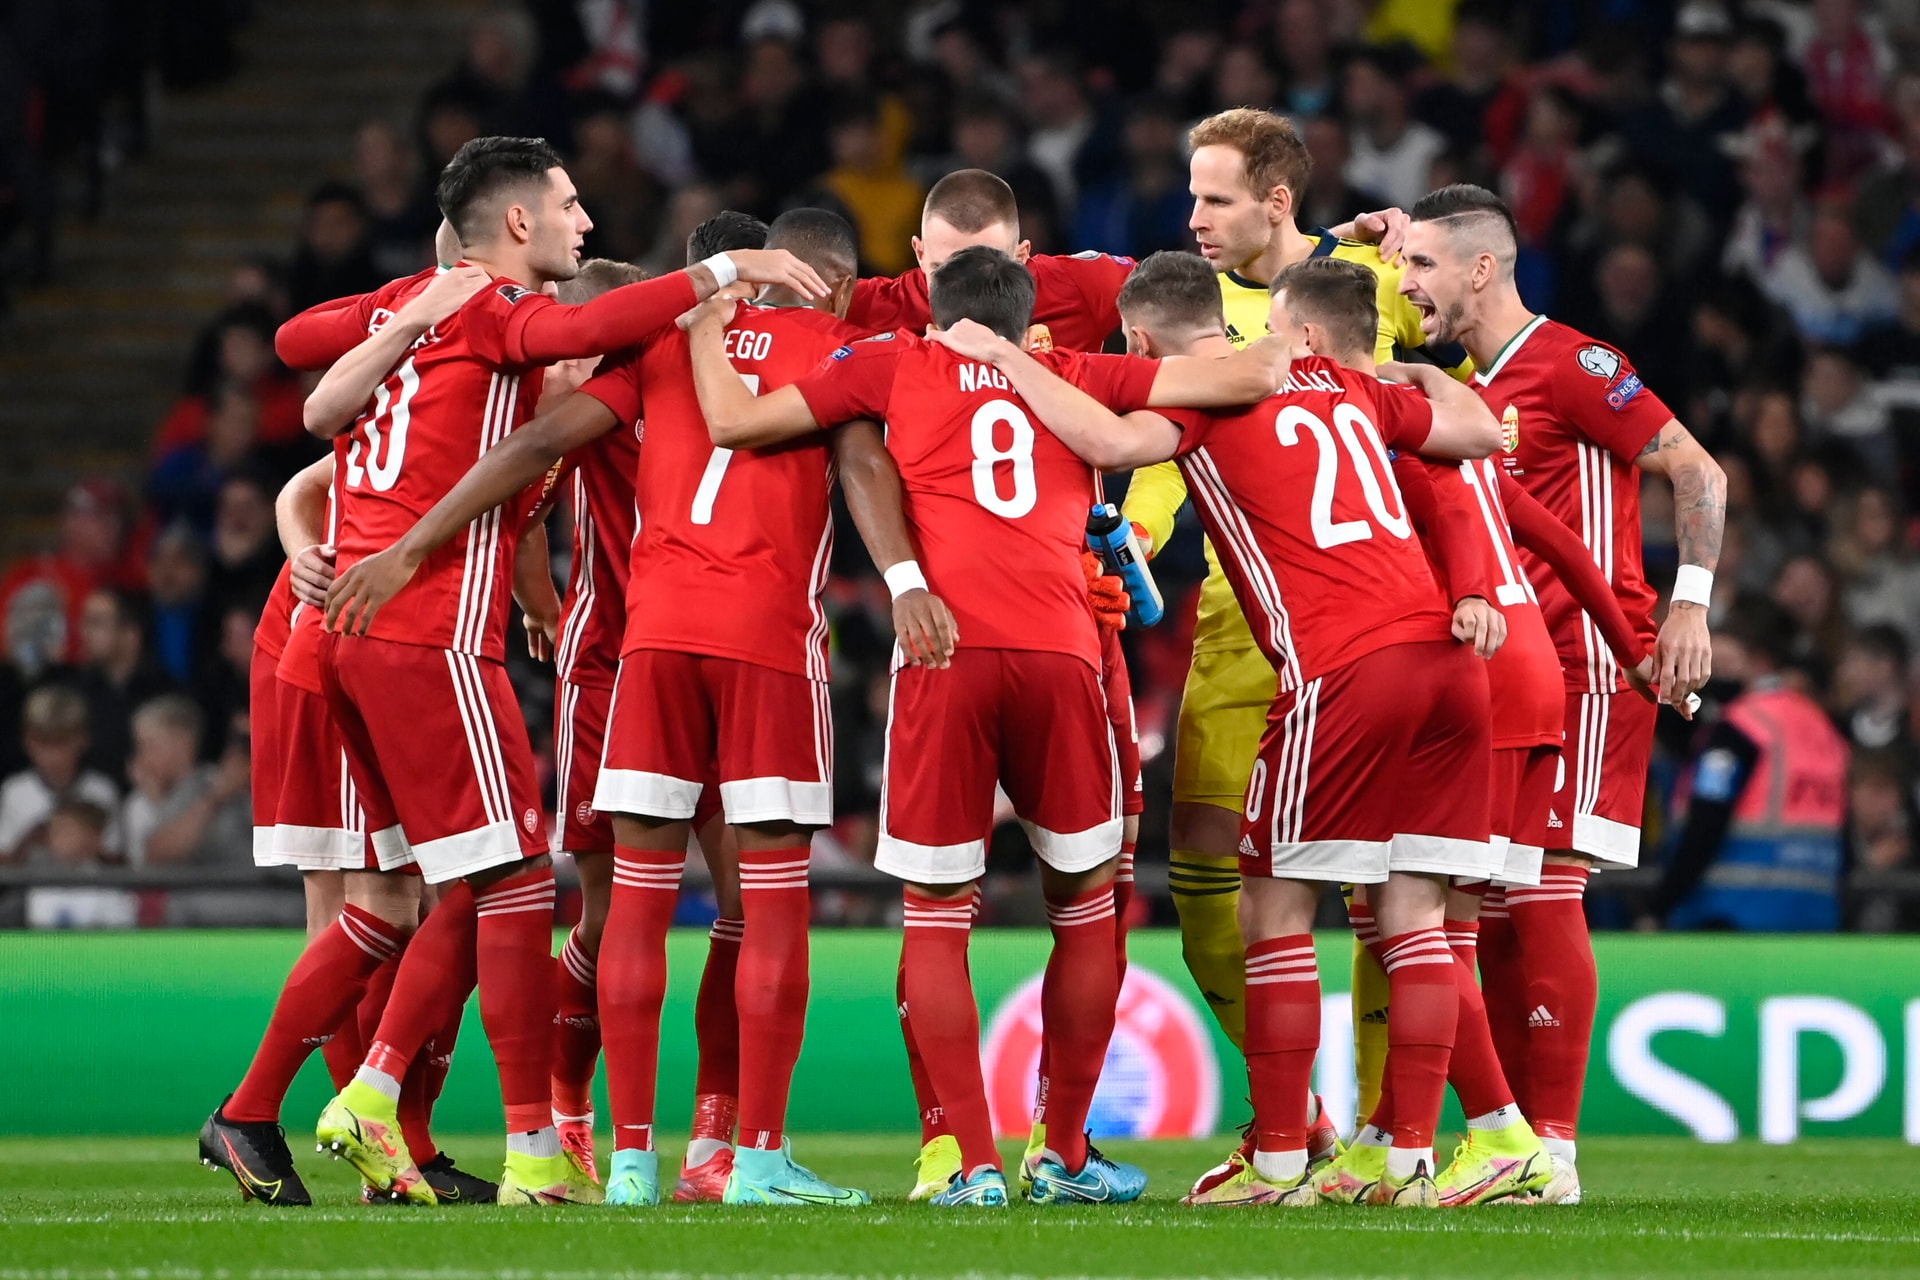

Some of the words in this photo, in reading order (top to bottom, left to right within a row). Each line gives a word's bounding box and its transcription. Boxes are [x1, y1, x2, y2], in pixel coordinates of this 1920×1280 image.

[724, 329, 773, 361] EGO
[959, 362, 1017, 395] NAG
[1275, 369, 1346, 395] ALLAI
[970, 398, 1038, 519] 8
[1275, 402, 1412, 549] 20
[1606, 991, 1920, 1145] SP
